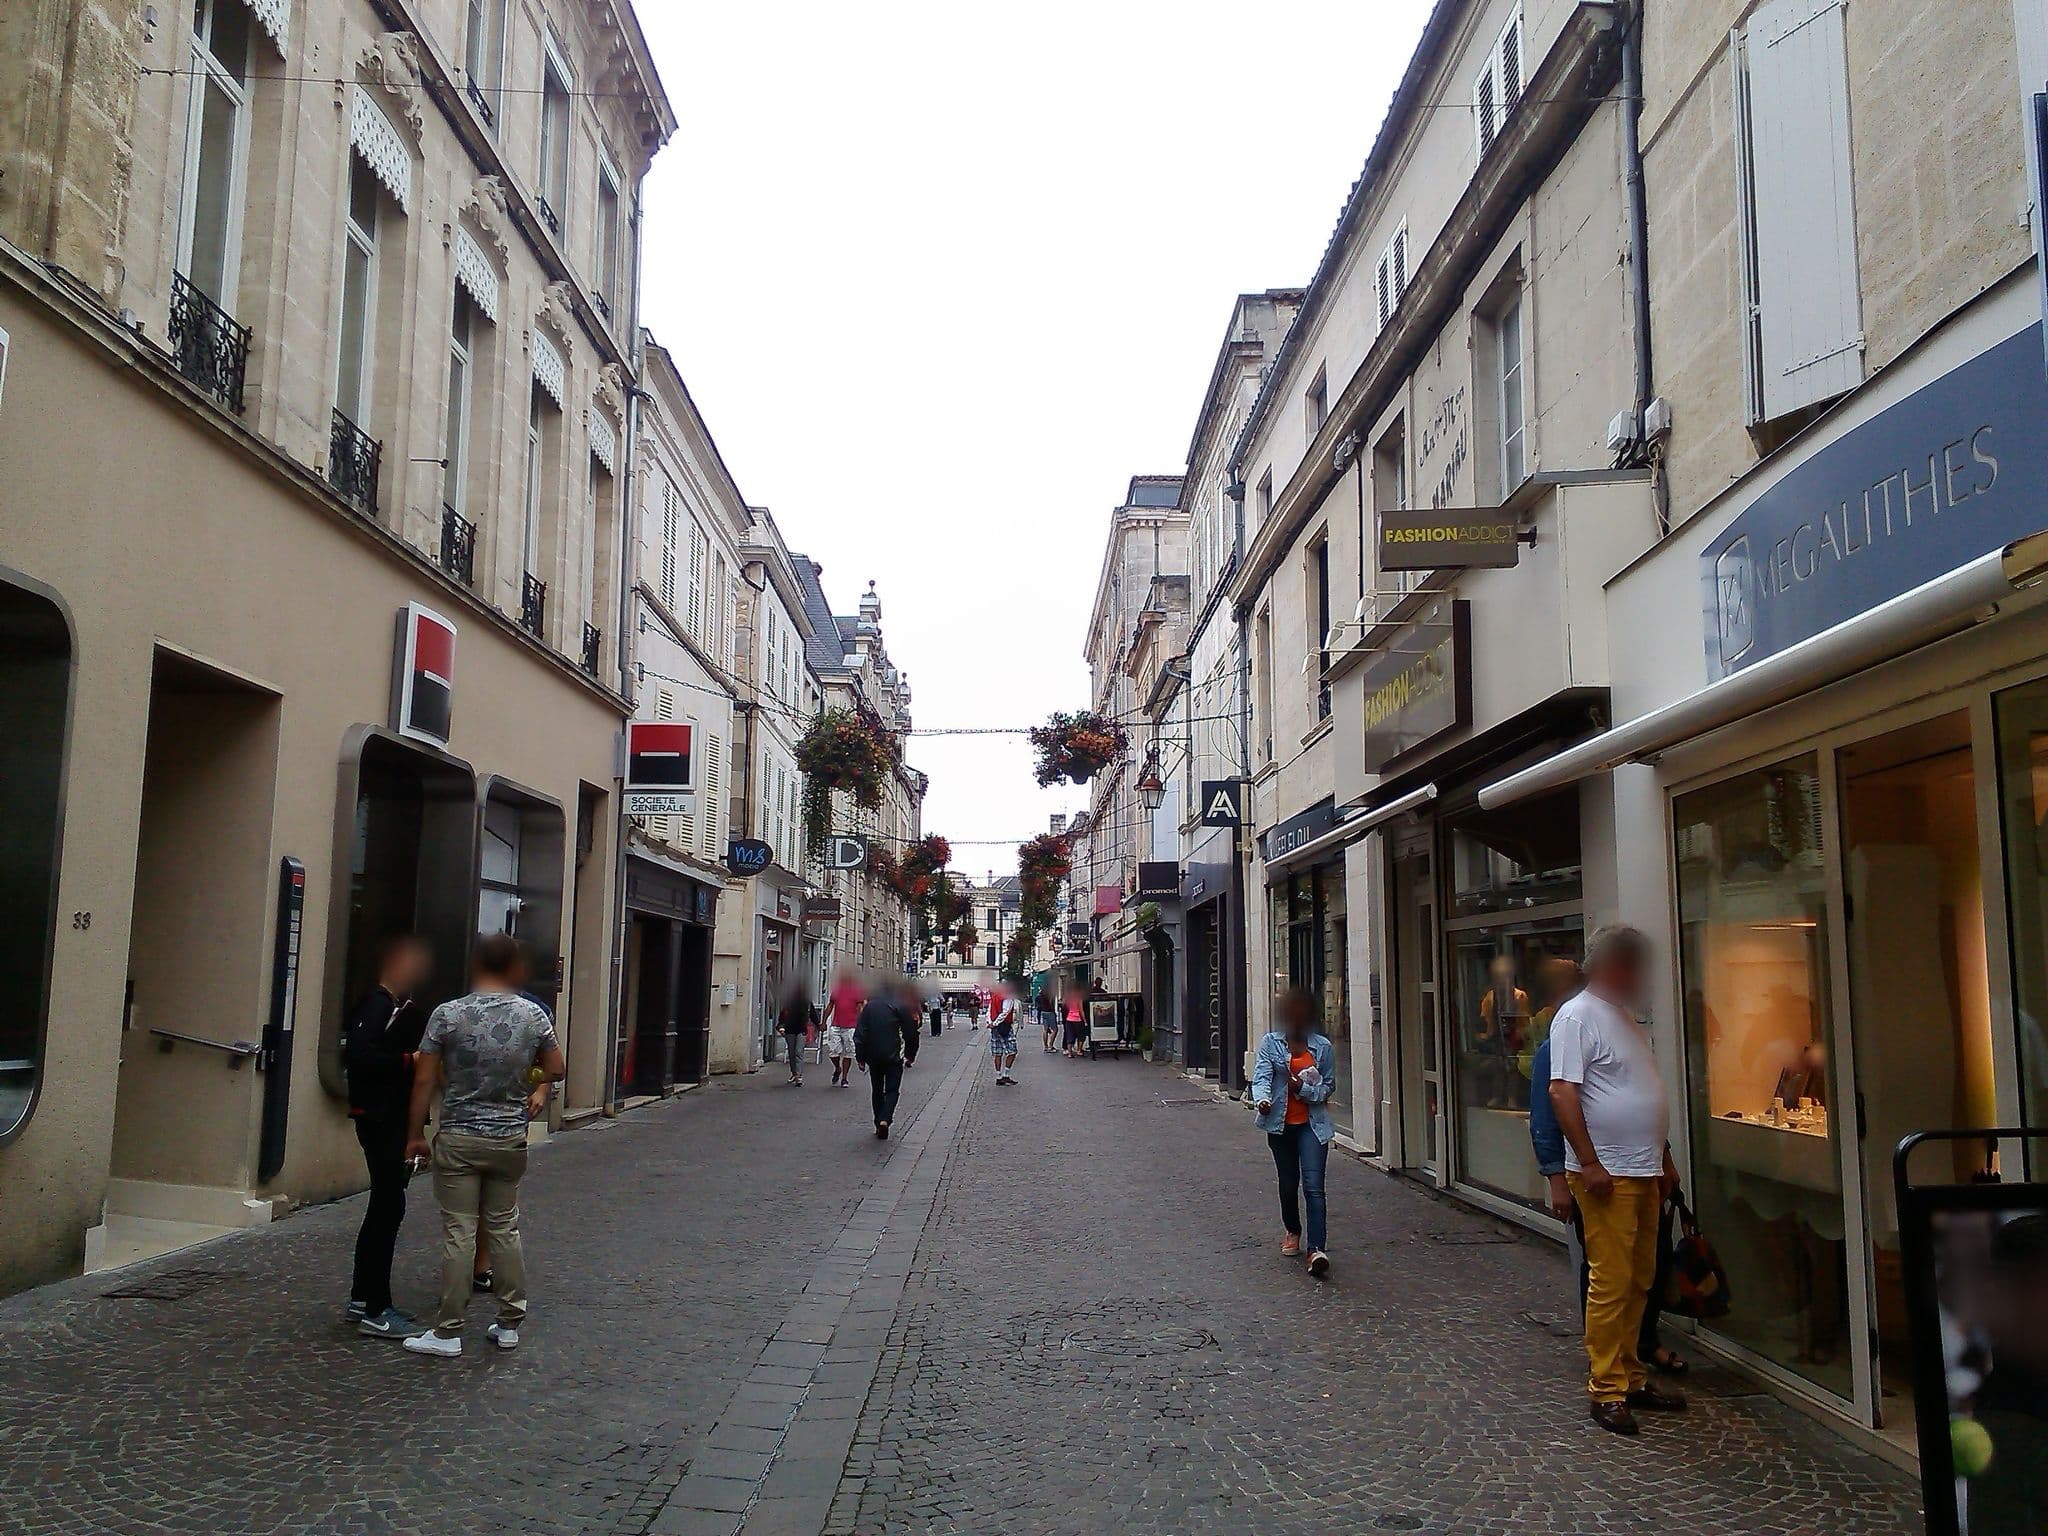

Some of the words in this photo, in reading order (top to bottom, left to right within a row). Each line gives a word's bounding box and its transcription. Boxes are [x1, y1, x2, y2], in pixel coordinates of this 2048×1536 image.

[1755, 424, 1999, 600] MEGALITHES
[631, 796, 676, 805] SOCIETE
[630, 804, 687, 813] GENERALE
[835, 838, 865, 867] D
[1142, 887, 1178, 896] promod
[72, 911, 92, 931] 33
